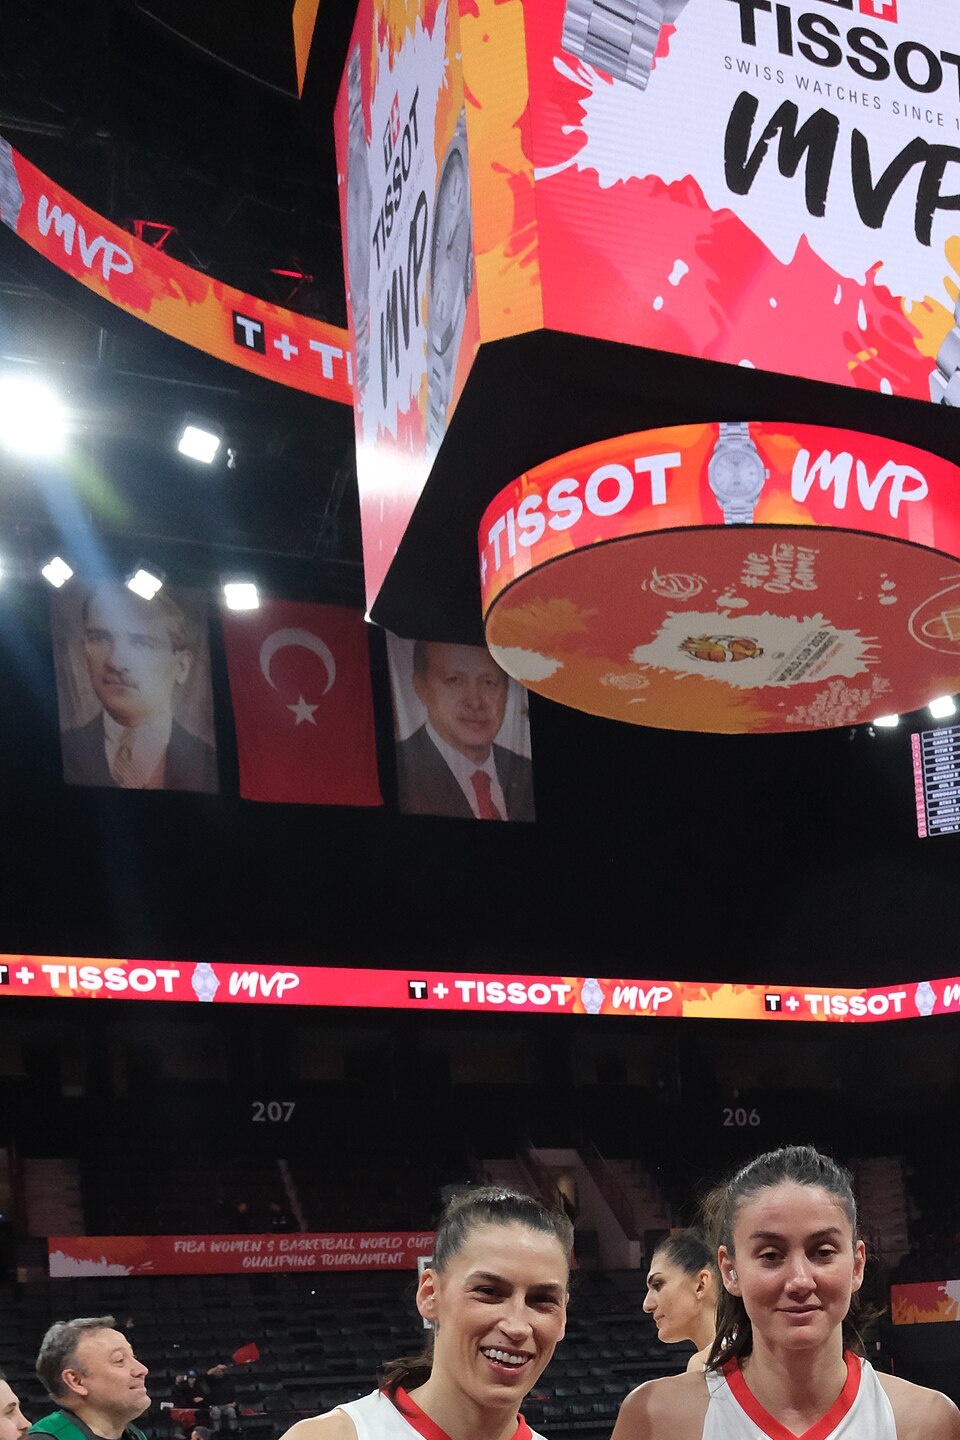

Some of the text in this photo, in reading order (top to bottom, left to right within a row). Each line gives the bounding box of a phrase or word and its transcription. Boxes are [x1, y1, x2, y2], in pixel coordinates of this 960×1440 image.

[724, 56, 785, 84] SWISS
[796, 75, 881, 110] WATCHES
[892, 101, 944, 126] SINCE
[373, 85, 419, 271] TISSOT
[37, 195, 134, 281] MVP
[380, 190, 429, 409] MVP
[488, 448, 929, 563] TISSOT MVP
[42, 964, 300, 998] TISSOT MVP
[455, 981, 571, 1006] TISSOT
[612, 986, 673, 1011] MVP
[804, 992, 906, 1016] TISSOT
[252, 1101, 296, 1122] 207
[722, 1107, 761, 1127] 206
[174, 1240, 205, 1253] FIBA
[280, 1237, 356, 1252] BASKETBALL
[360, 1237, 402, 1250] WORLD
[242, 1251, 405, 1269] QUALIFYING TOURNAMENT
